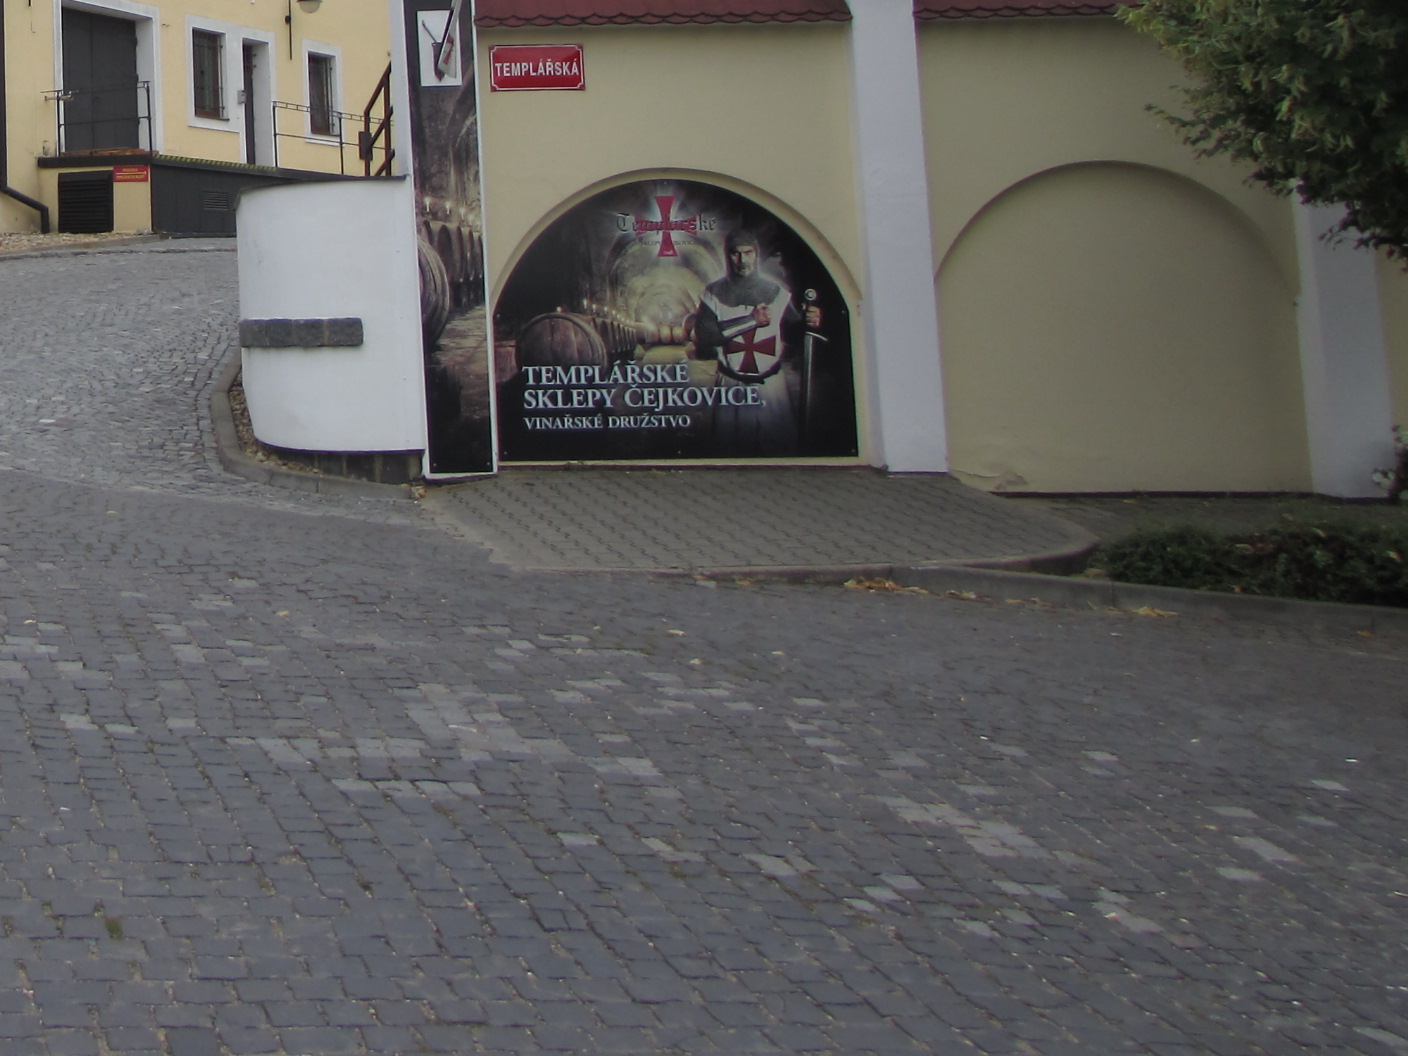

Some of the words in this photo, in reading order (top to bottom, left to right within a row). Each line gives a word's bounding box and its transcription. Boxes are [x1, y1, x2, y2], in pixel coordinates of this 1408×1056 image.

[495, 58, 580, 77] TEMPLÁŘSKÁ
[522, 360, 689, 386] TEMPLÁŘSKÉ
[523, 388, 617, 409] SKLEPY
[624, 382, 766, 412] ČEJKOVICE,
[523, 413, 603, 430] VINAŘSKÉ
[608, 413, 691, 430] DRUŽSTVO
